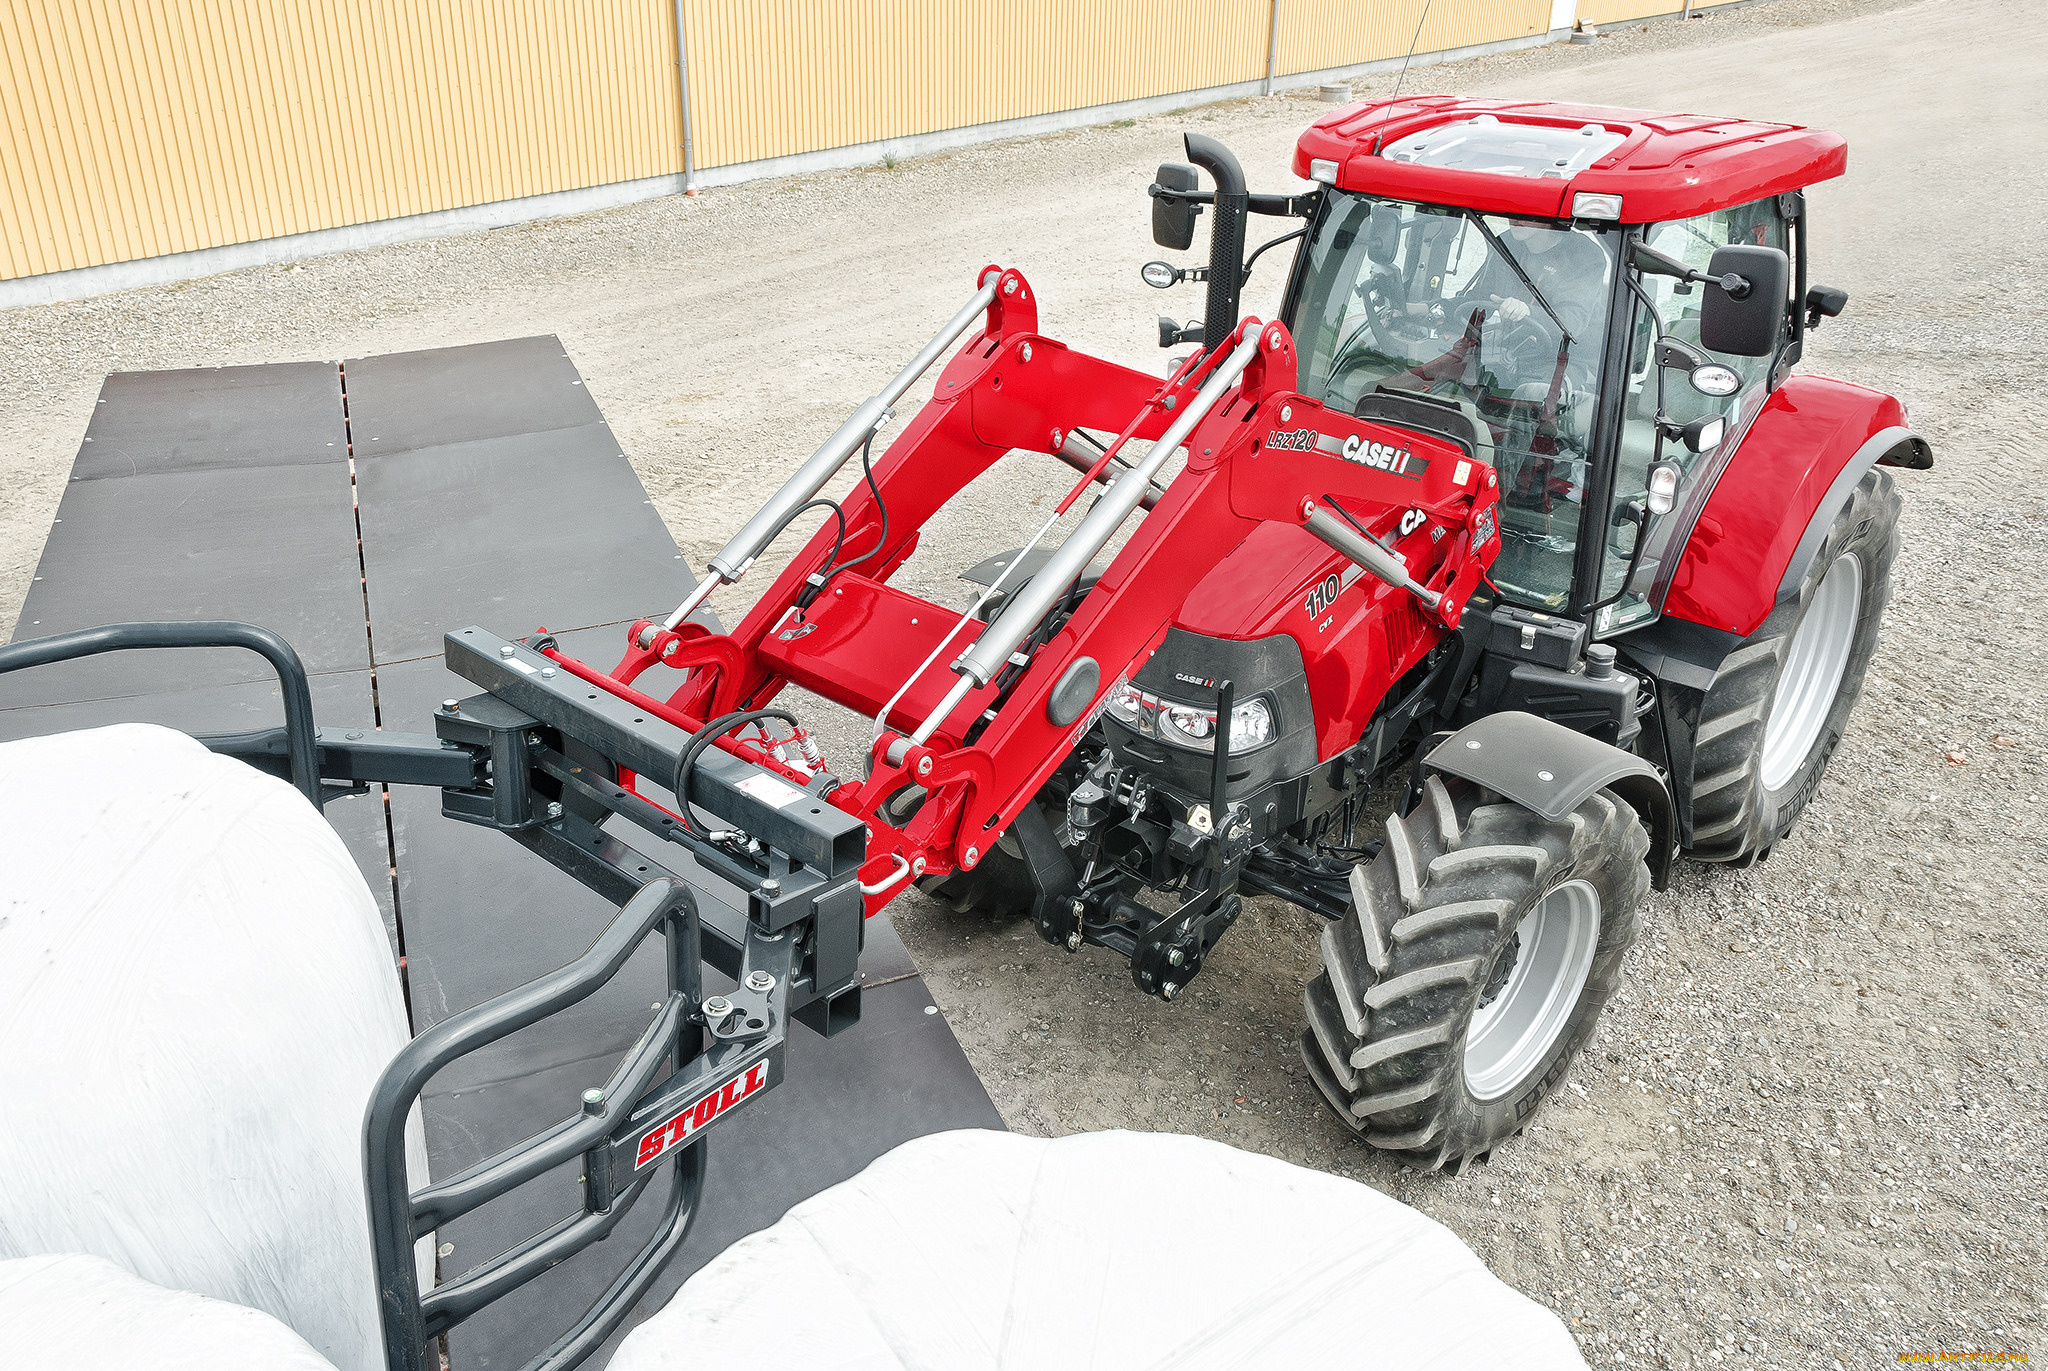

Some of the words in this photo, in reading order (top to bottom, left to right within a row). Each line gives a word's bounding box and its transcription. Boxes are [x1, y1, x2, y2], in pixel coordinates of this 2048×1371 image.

[1265, 428, 1317, 452] LRZ120
[1342, 434, 1395, 470] CASE
[1401, 509, 1427, 535] CA
[1305, 573, 1339, 621] 110
[1319, 614, 1333, 633] CVX
[1175, 673, 1203, 685] CASE
[636, 1062, 765, 1167] STOLL
